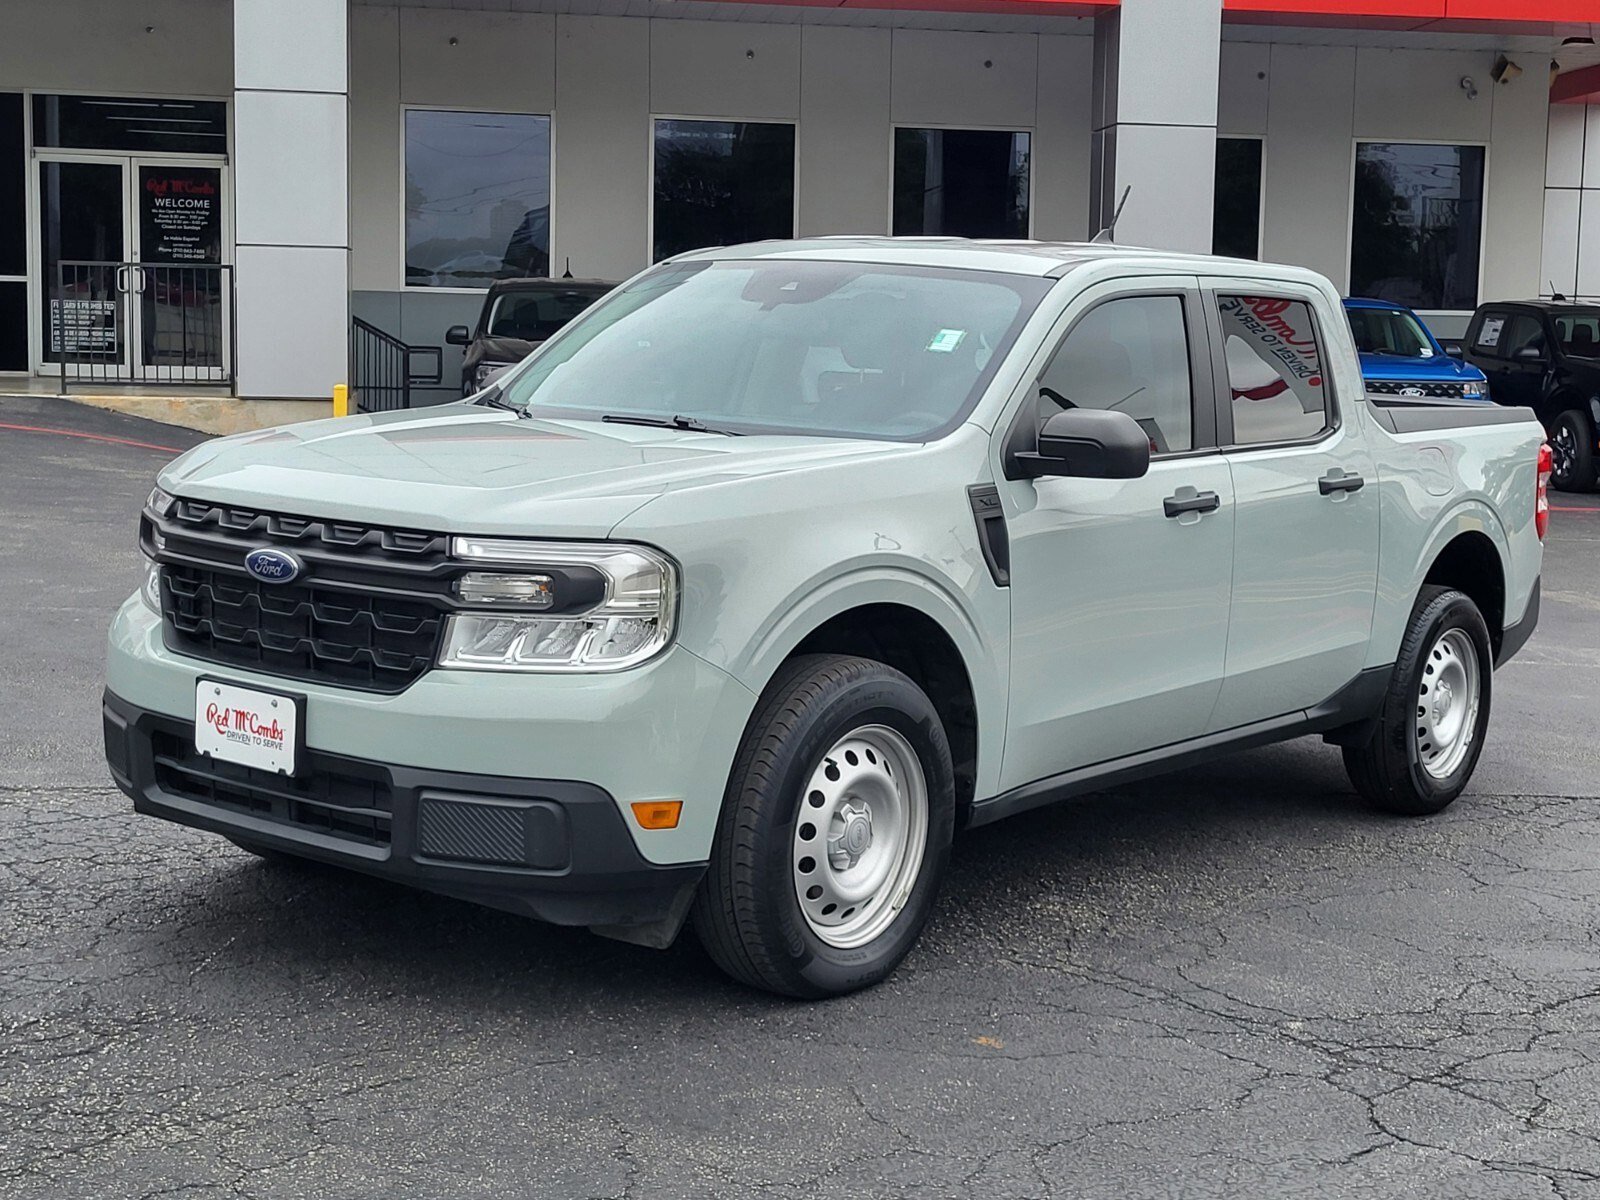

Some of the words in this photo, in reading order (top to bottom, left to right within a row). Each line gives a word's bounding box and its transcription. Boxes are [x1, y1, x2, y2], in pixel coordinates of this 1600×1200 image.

[154, 198, 210, 208] WELCOME
[254, 555, 284, 577] Ford
[206, 702, 230, 735] Red
[232, 708, 284, 741] McCombs
[226, 730, 251, 743] DRIVEN
[252, 736, 262, 746] TO
[262, 739, 283, 751] SERVE
